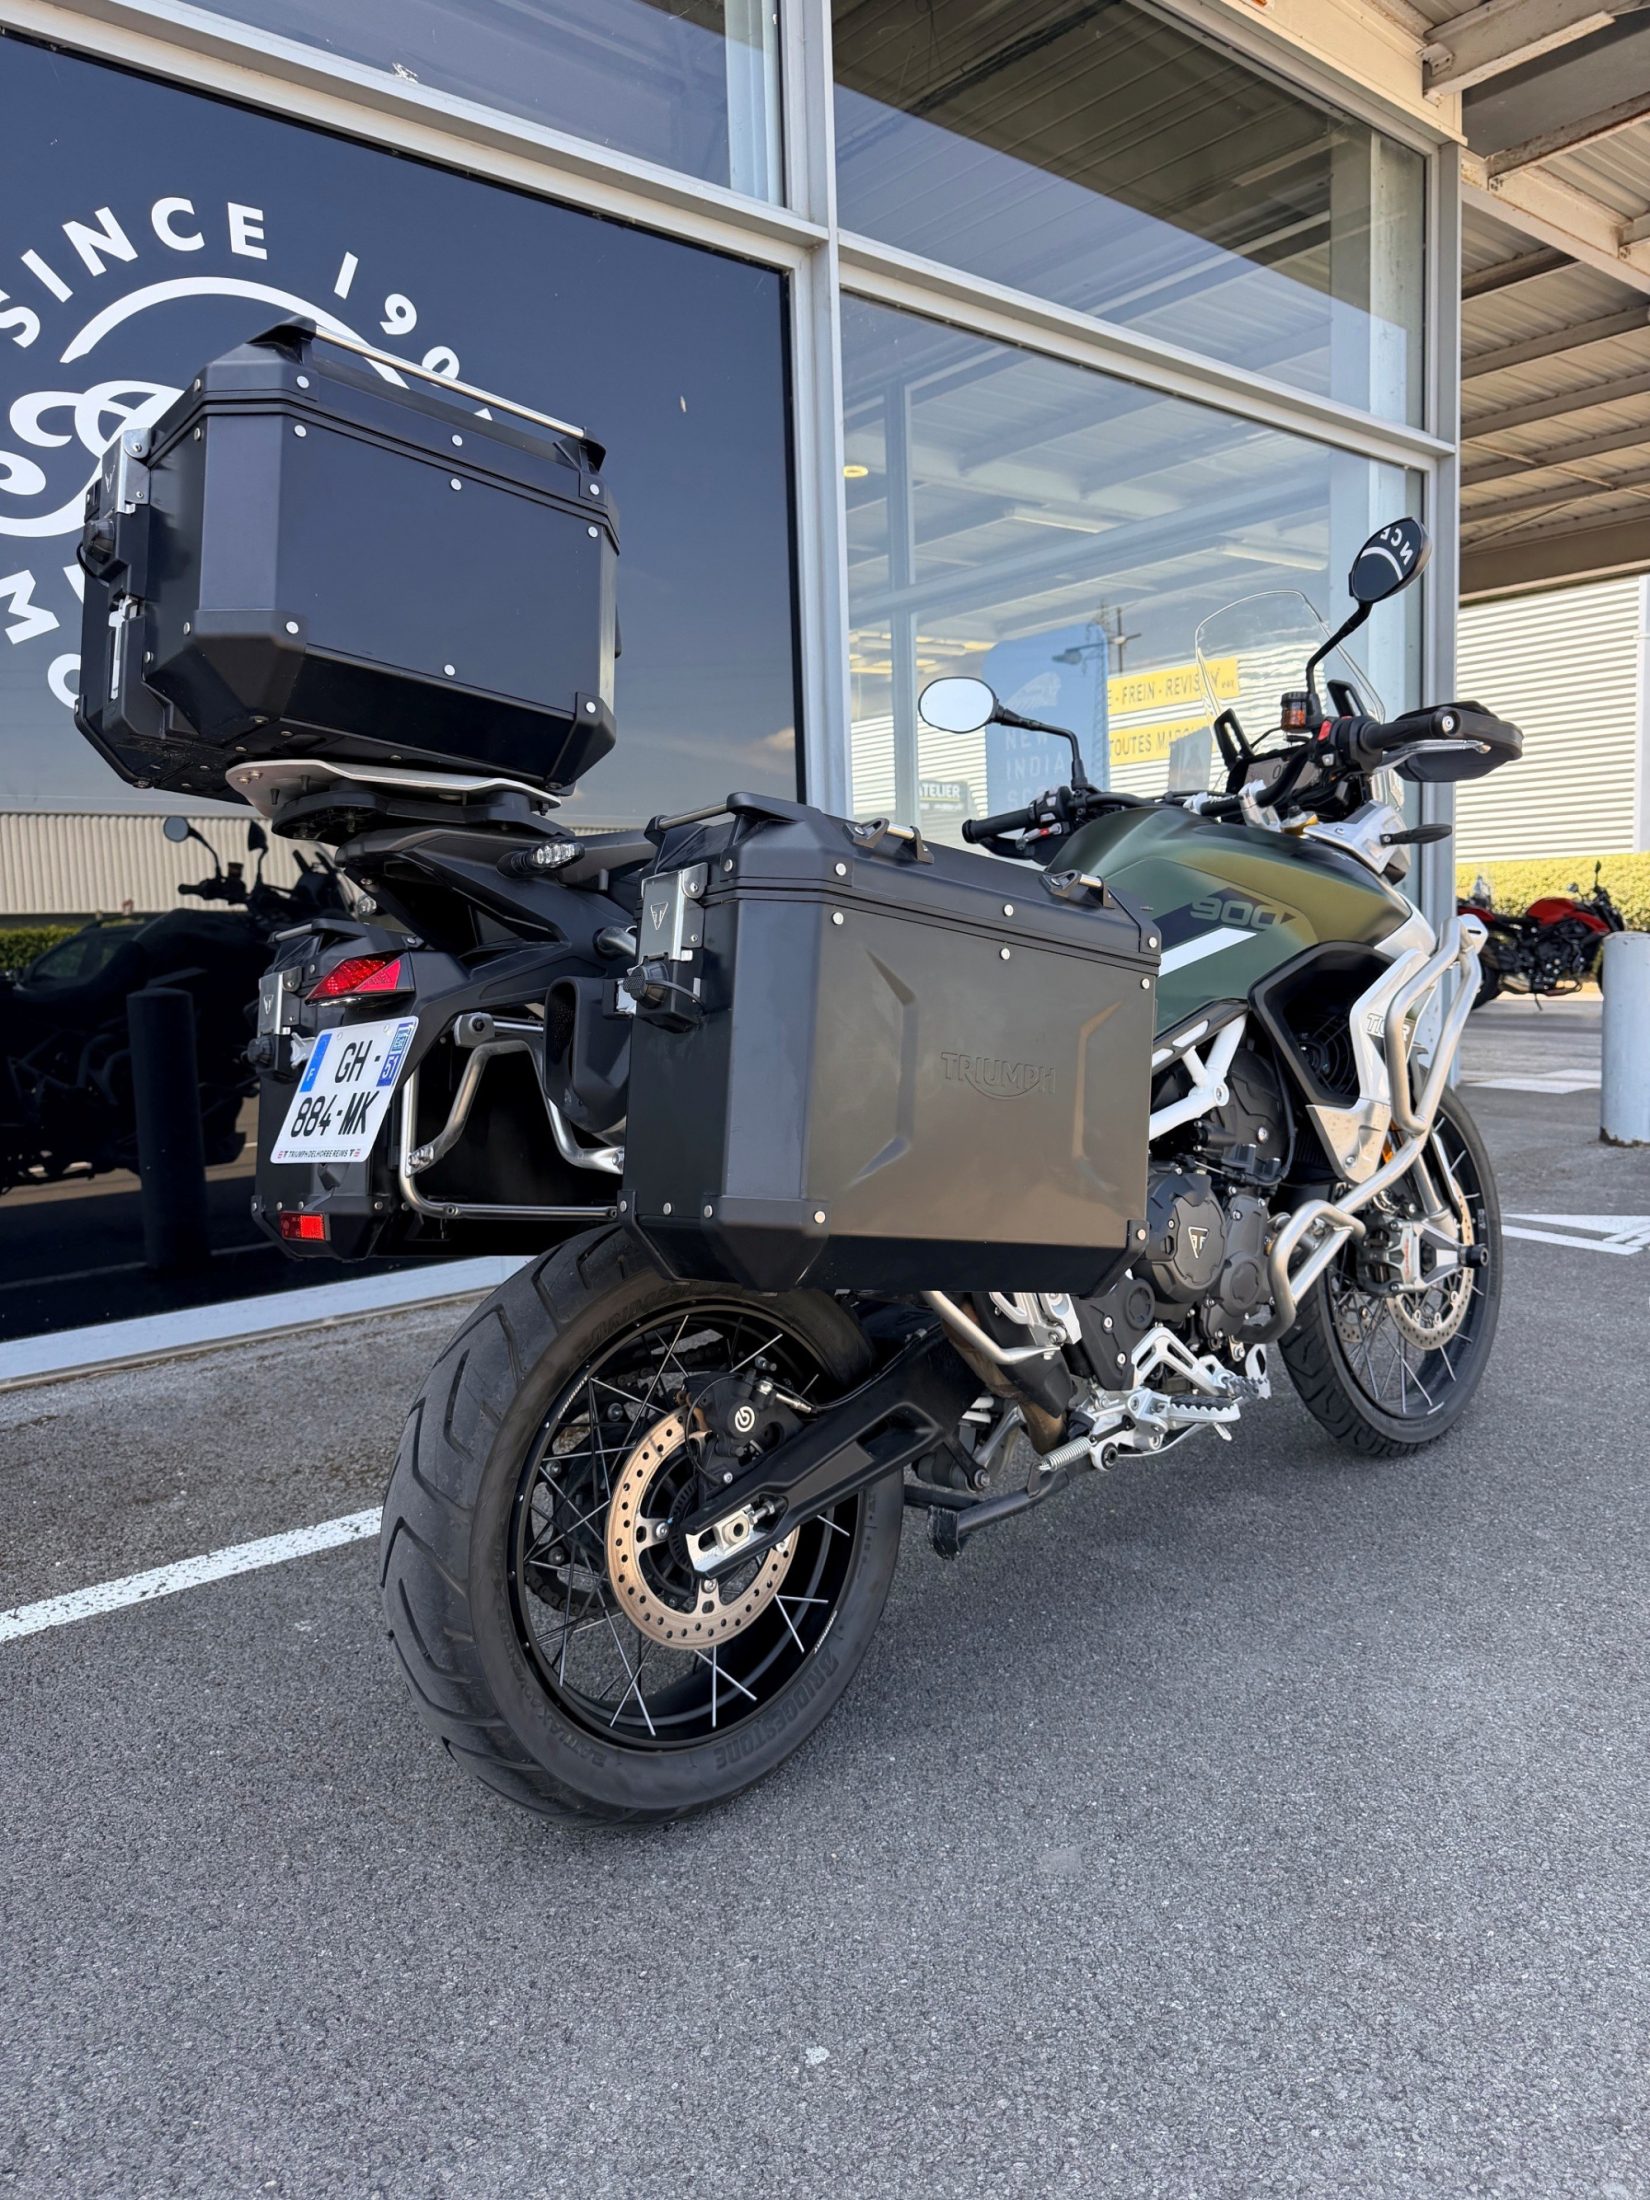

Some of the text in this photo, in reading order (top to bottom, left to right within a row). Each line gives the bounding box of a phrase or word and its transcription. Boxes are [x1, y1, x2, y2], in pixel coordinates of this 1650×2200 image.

[0, 197, 492, 421] SINCE 190
[1121, 681, 1156, 705] FREIN
[1005, 751, 1066, 782] INDIA
[1189, 897, 1282, 930] 900
[382, 1055, 400, 1079] 51
[940, 1051, 1056, 1097] TRIUMPH
[290, 1090, 381, 1138] 884-MK
[712, 1646, 841, 1771] BRIDGESTONE
